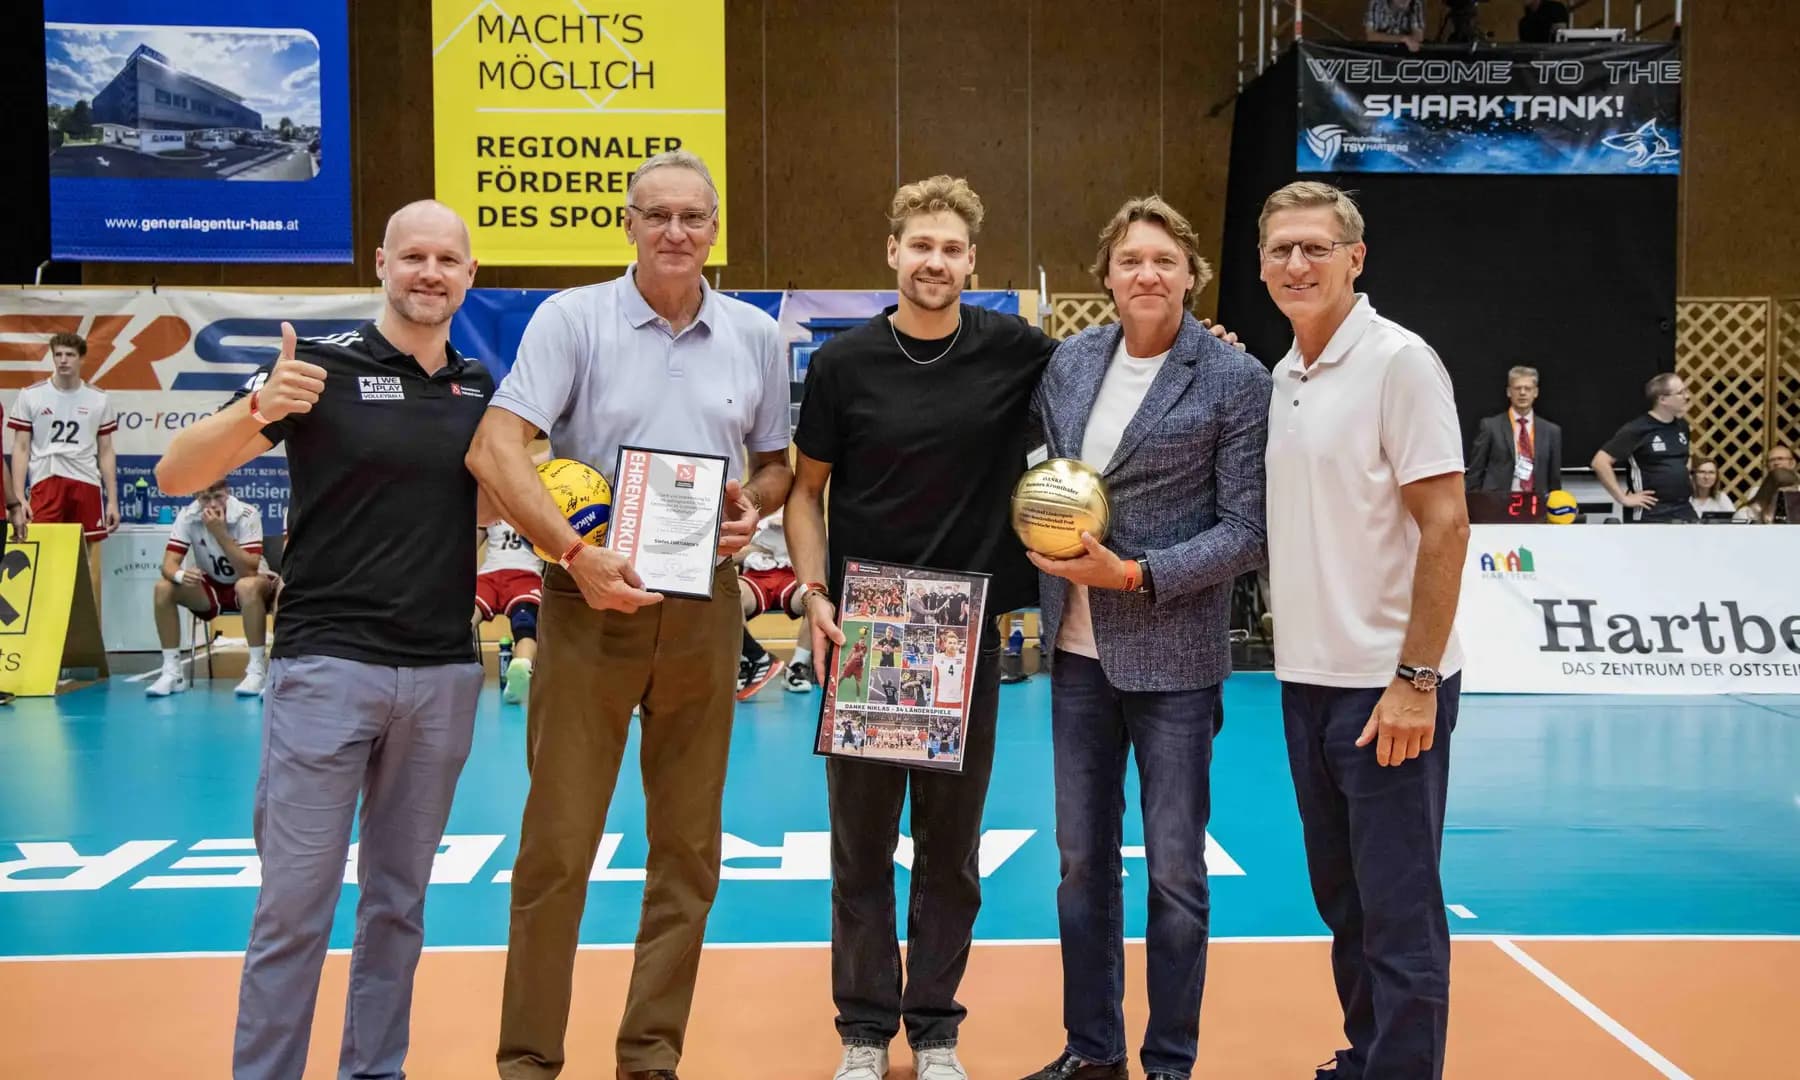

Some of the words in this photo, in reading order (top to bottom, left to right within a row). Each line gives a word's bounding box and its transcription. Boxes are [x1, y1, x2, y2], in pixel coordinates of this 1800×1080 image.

[478, 53, 655, 91] MÖGLICH
[1305, 58, 1513, 84] WELCOME
[1531, 60, 1584, 85] TO
[1603, 60, 1682, 85] THE
[1363, 94, 1625, 121] SHARKTANK!
[476, 135, 683, 159] REGIONALER
[1342, 143, 1366, 153] TSV
[105, 217, 300, 232] www.generalagentur-haas.at
[478, 206, 538, 229] DES
[50, 420, 80, 445] 22
[1508, 494, 1538, 517] 21
[208, 554, 235, 577] 16
[1562, 661, 1596, 676] DAS
[1601, 662, 1685, 677] ZENTRUM
[1692, 663, 1725, 677] DER
[1730, 663, 1800, 677] OSTSTEI
